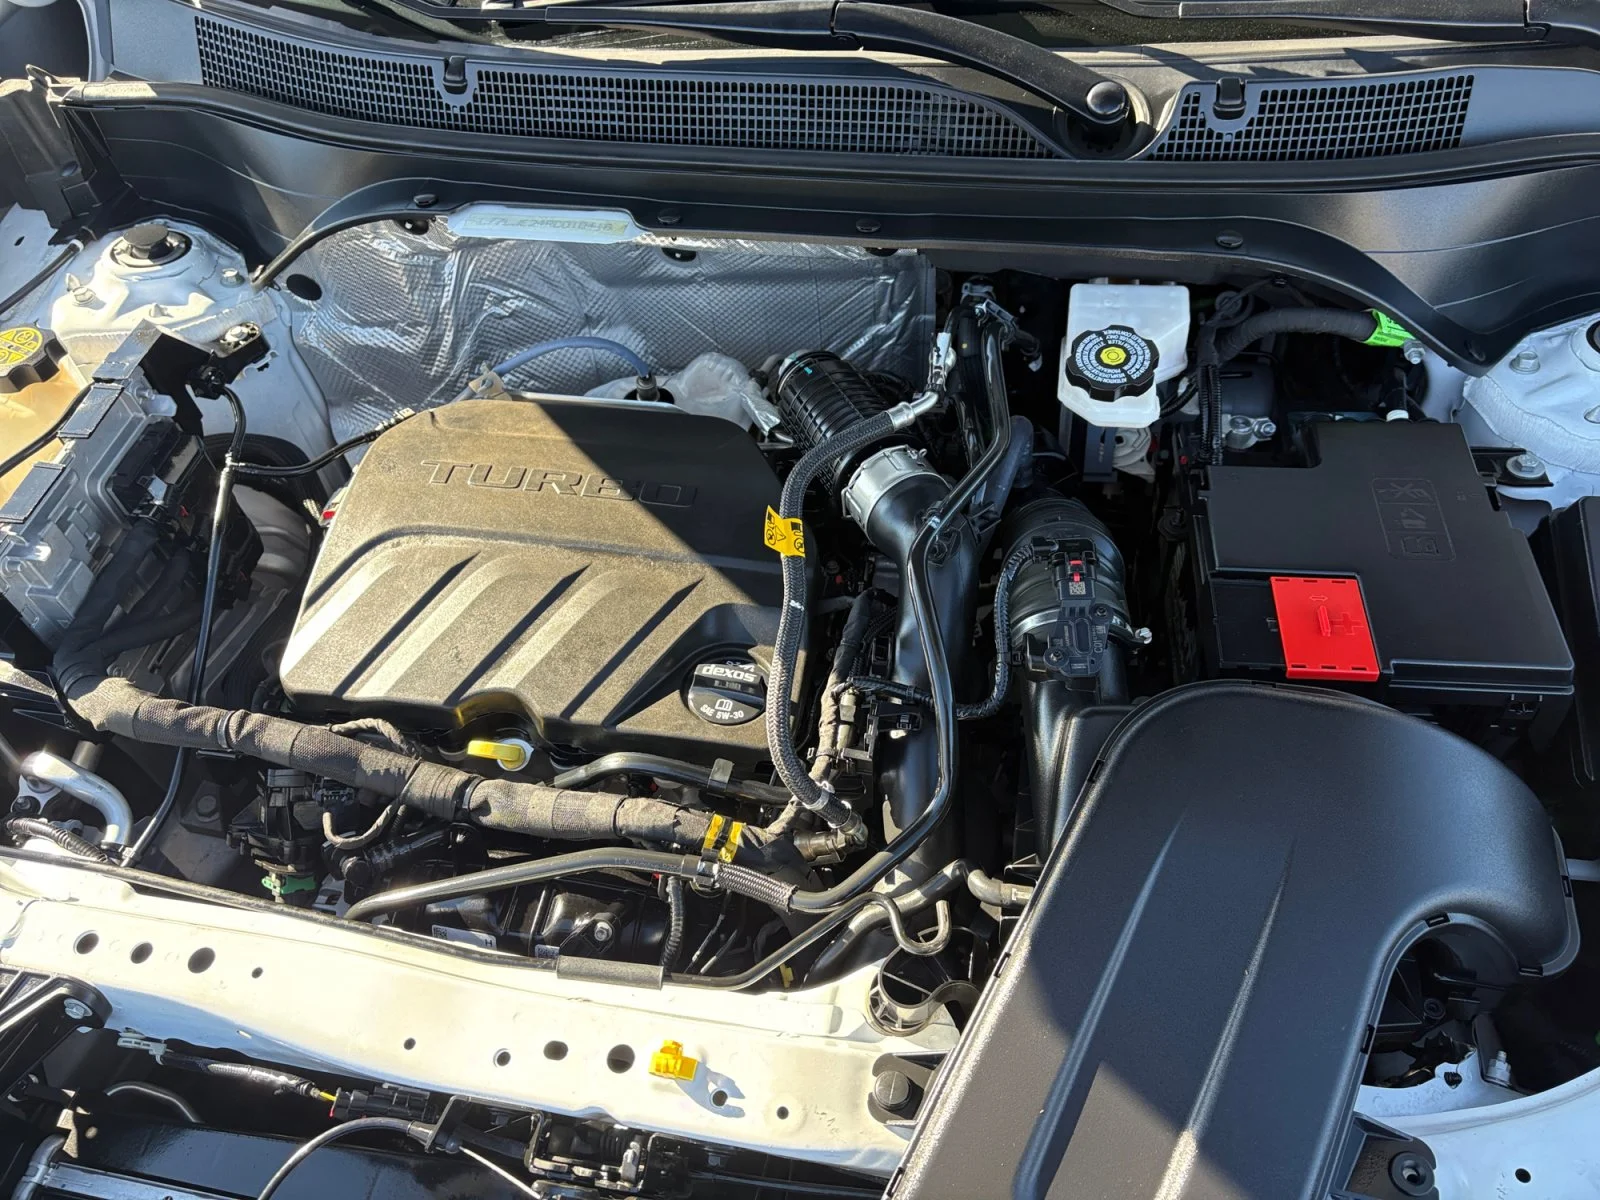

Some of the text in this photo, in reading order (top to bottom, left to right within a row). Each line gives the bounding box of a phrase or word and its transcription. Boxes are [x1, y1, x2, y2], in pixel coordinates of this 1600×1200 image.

[420, 459, 698, 508] TURBO
[702, 664, 757, 682] dexos
[700, 704, 745, 720] SAE 5W-30
